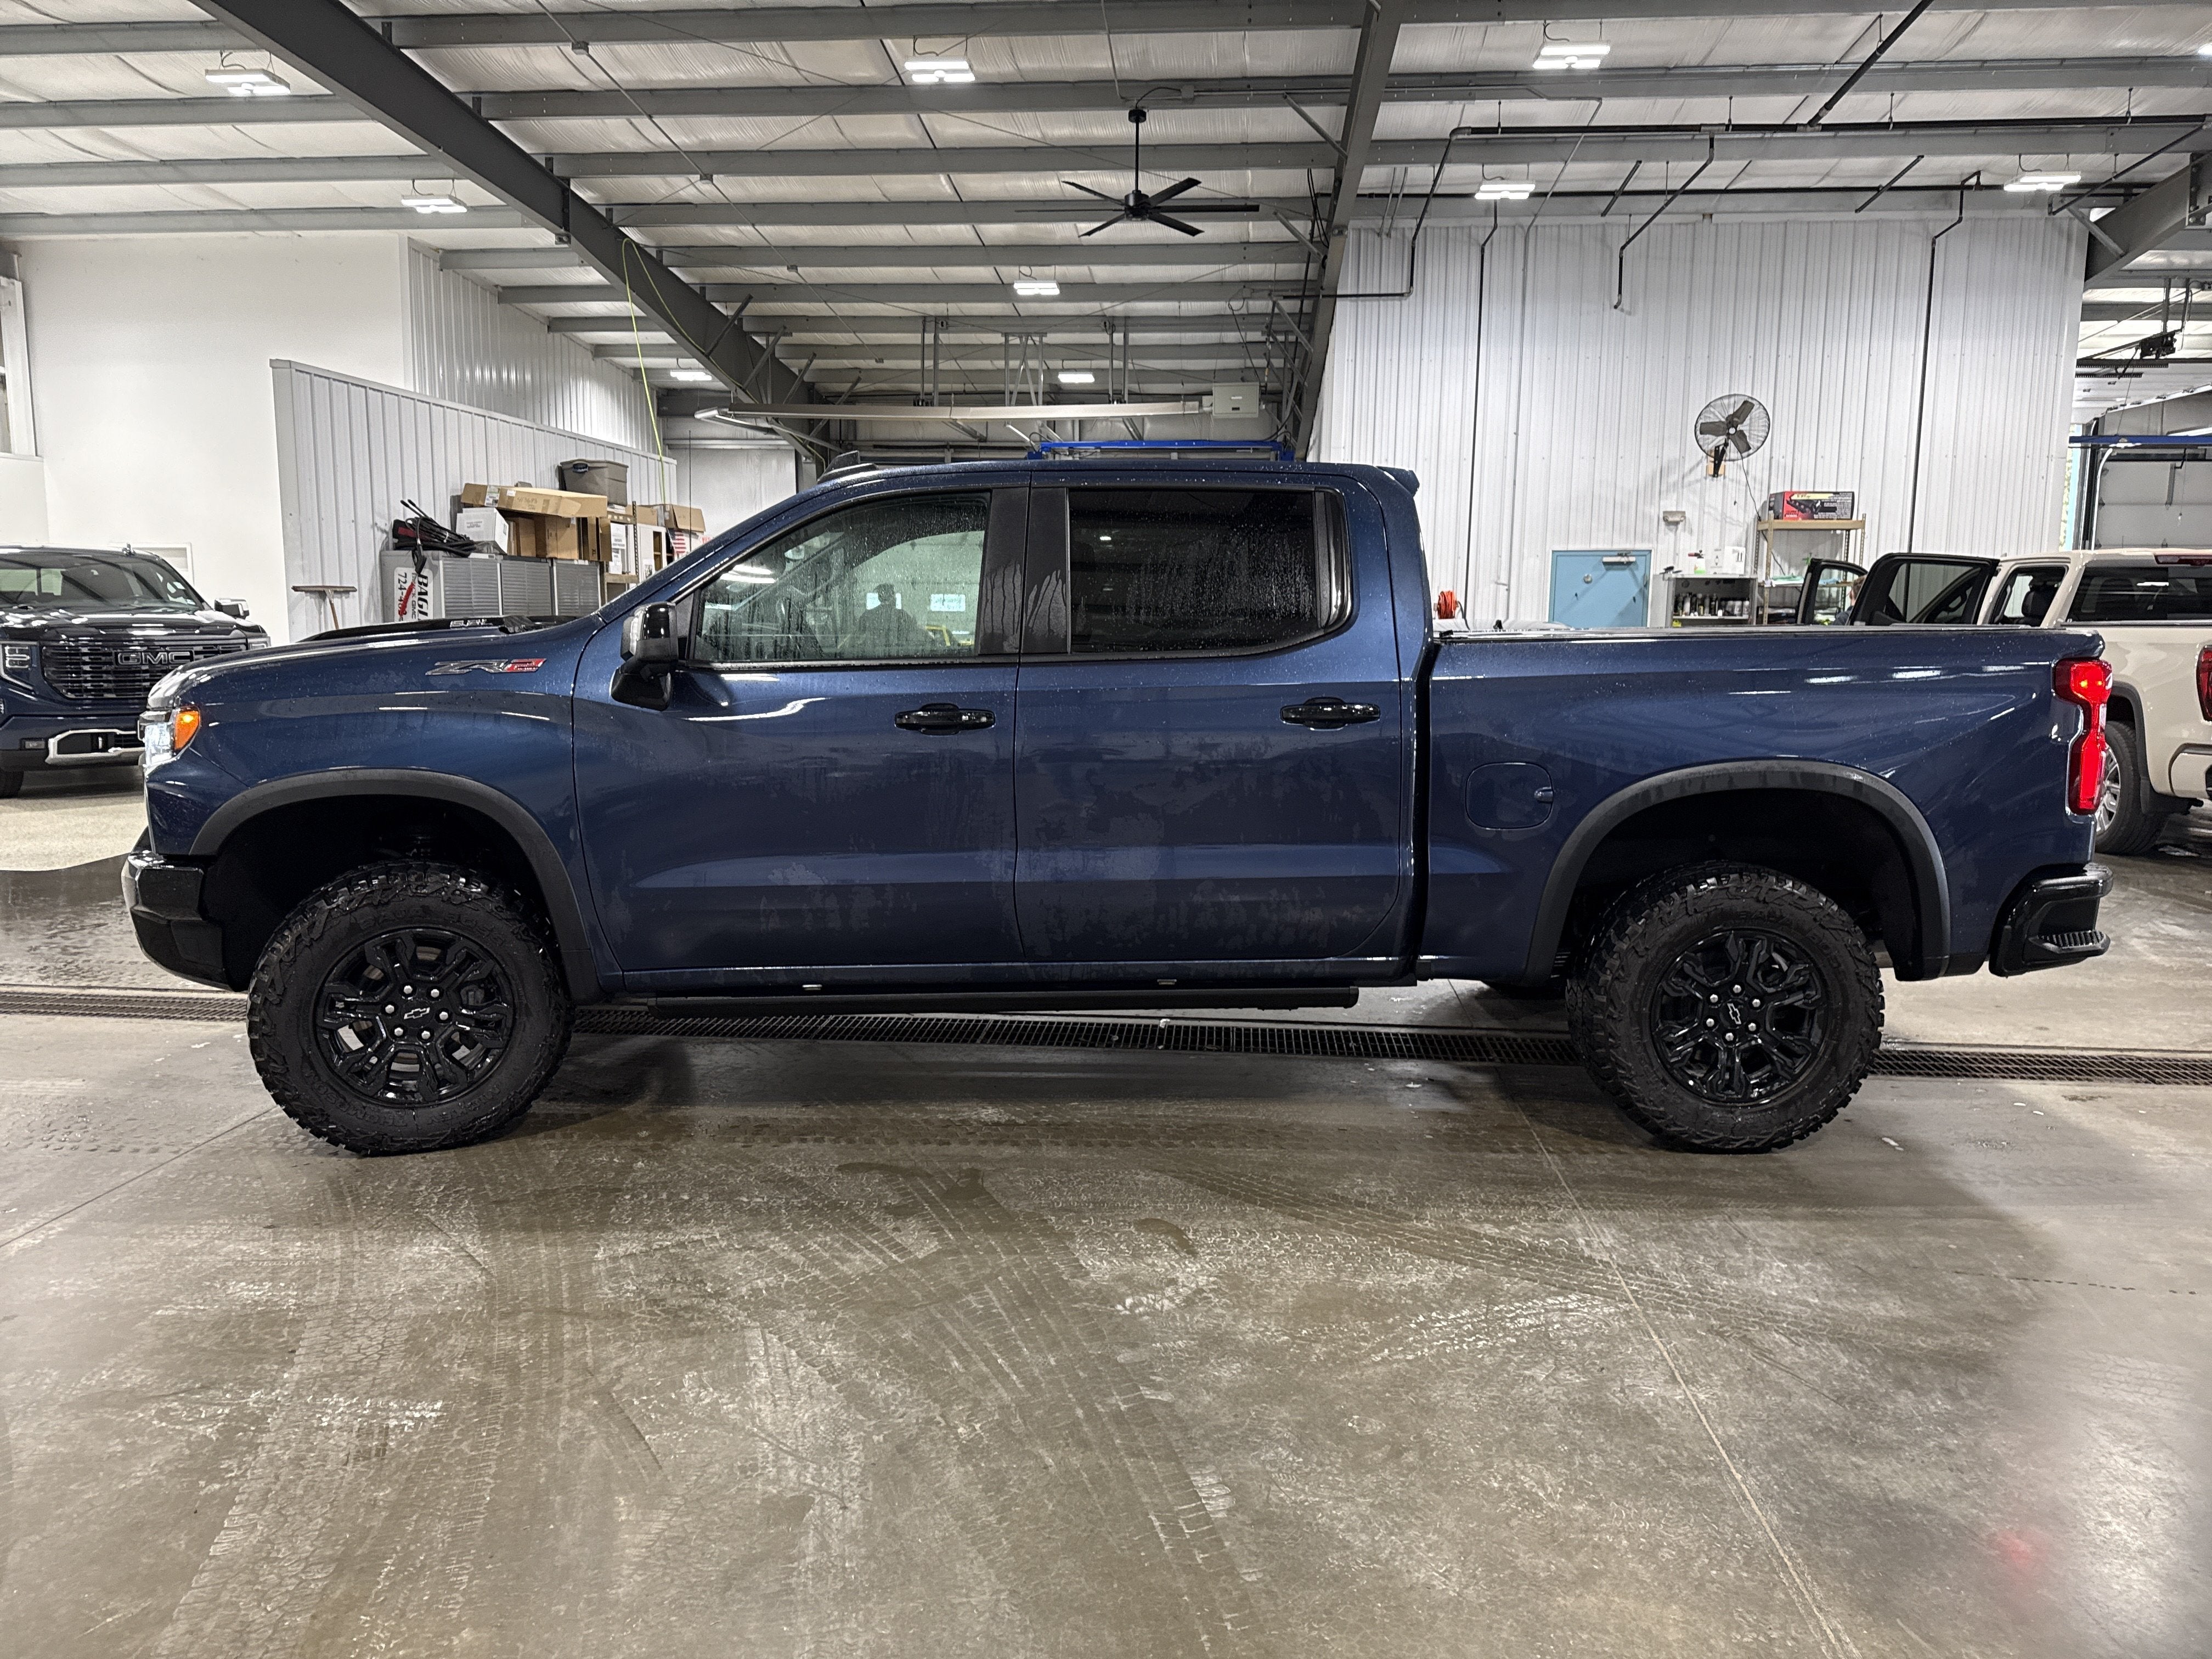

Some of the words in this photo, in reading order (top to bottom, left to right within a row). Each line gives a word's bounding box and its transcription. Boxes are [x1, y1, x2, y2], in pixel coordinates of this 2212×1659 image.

[417, 574, 428, 620] BAGL
[117, 651, 190, 665] GMC
[425, 658, 547, 676] ZR2
